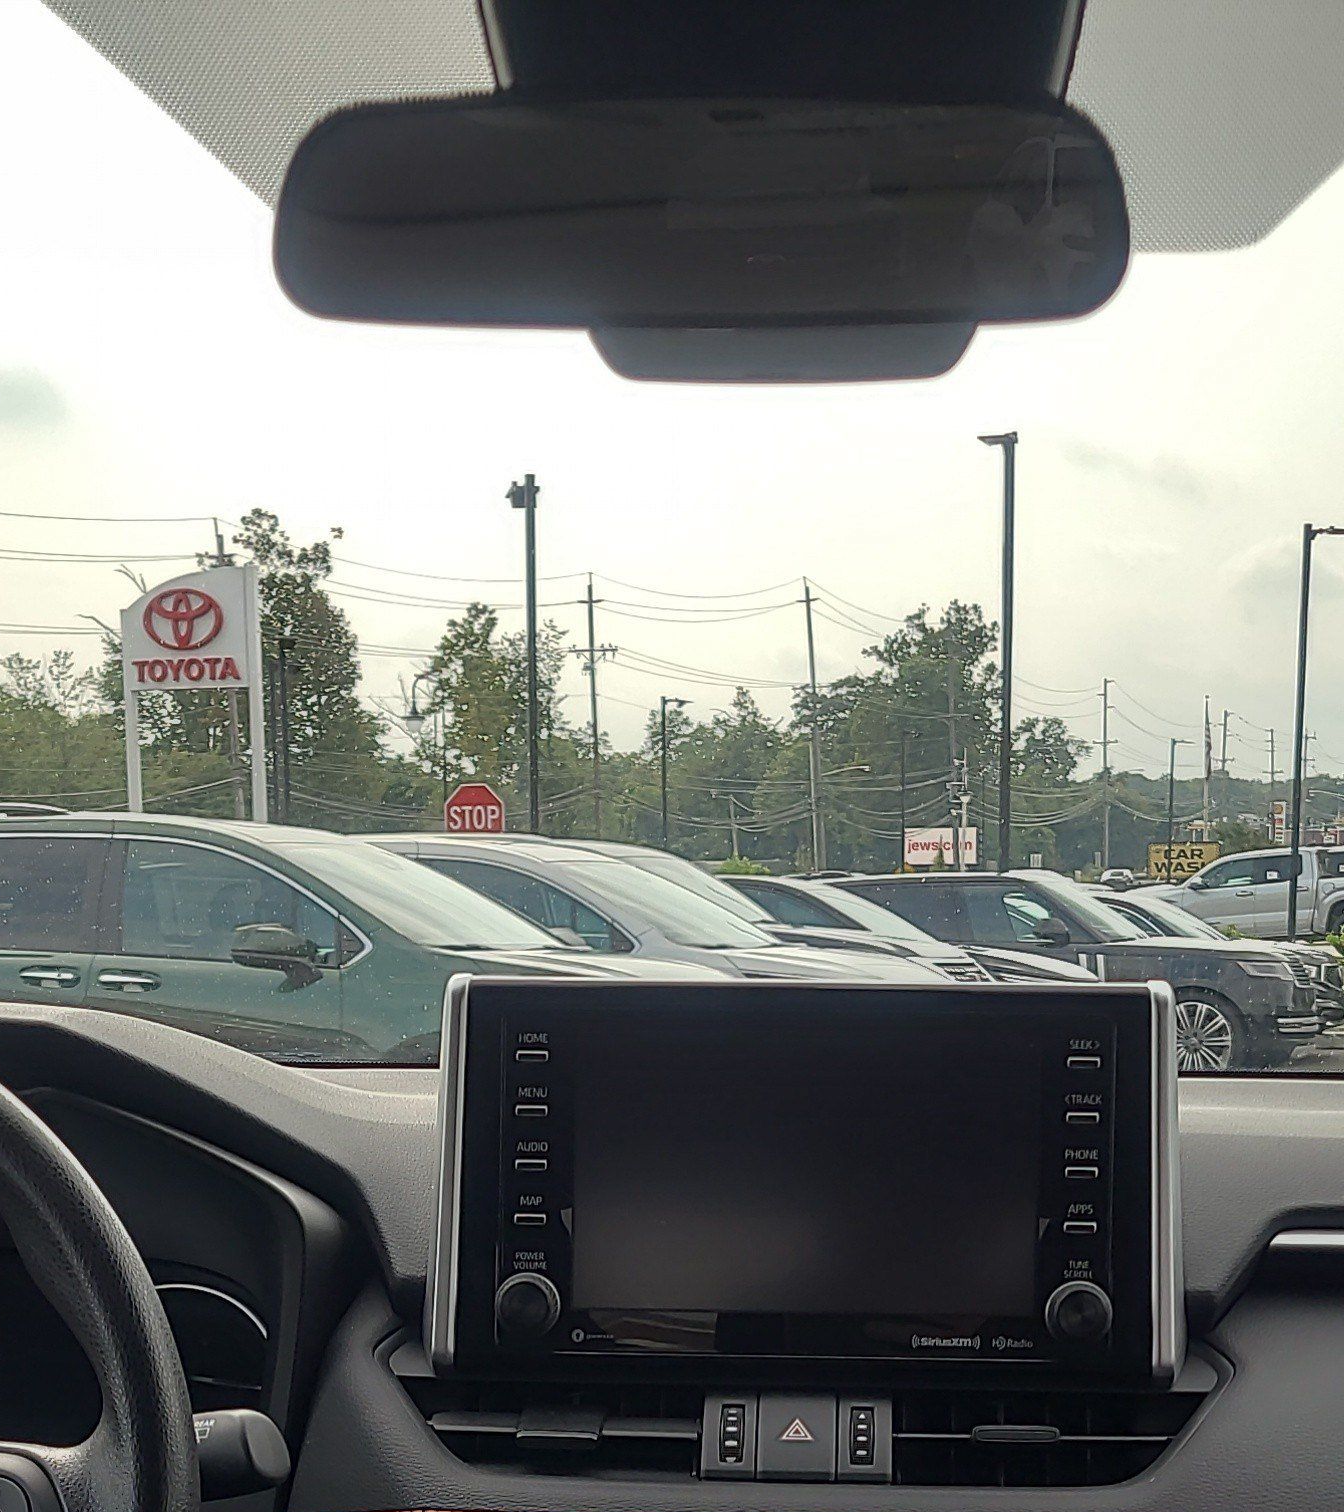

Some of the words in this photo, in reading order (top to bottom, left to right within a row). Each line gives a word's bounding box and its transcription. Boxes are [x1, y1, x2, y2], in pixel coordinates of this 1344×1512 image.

[131, 657, 241, 682] TOYOTA
[449, 805, 499, 830] STOP
[1164, 849, 1203, 860] CAR
[1154, 861, 1205, 873] WAS
[518, 1086, 548, 1098] MENU
[517, 1141, 549, 1152] AUDIO
[1065, 1149, 1099, 1160] PHONE
[520, 1196, 543, 1206] MAP
[1069, 1204, 1094, 1215] APPS
[515, 1252, 544, 1260] POWER
[513, 1261, 547, 1270] VOLUME
